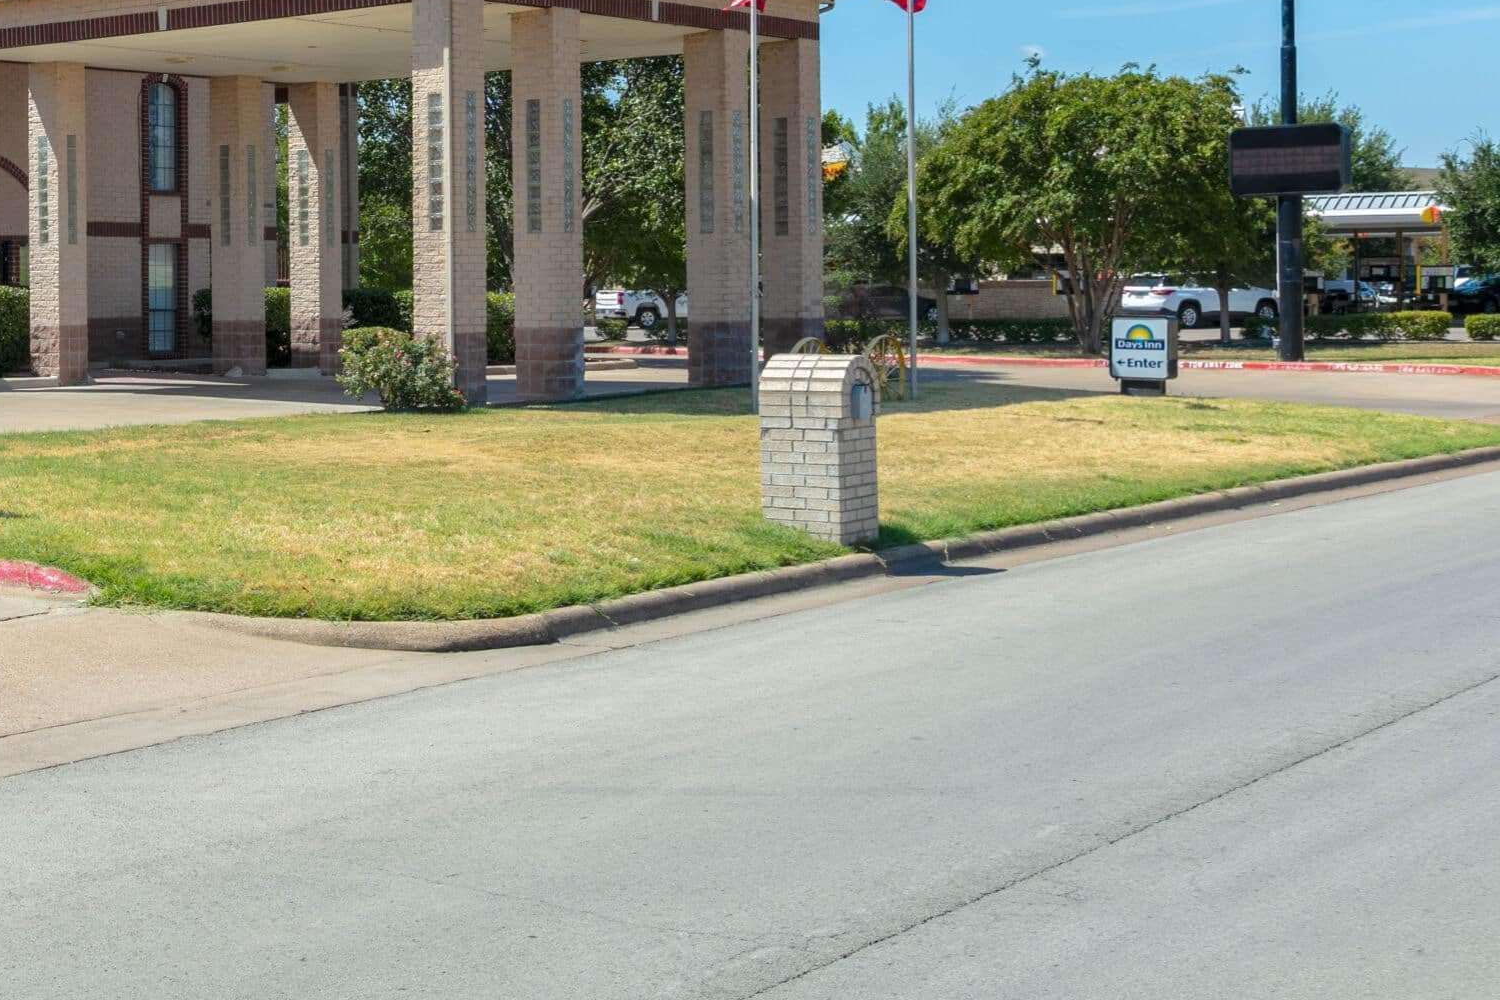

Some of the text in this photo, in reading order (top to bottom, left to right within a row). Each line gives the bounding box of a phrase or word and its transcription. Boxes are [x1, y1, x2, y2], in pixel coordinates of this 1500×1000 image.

[1118, 340, 1162, 349] Days Inn
[1127, 358, 1164, 369] Enter
